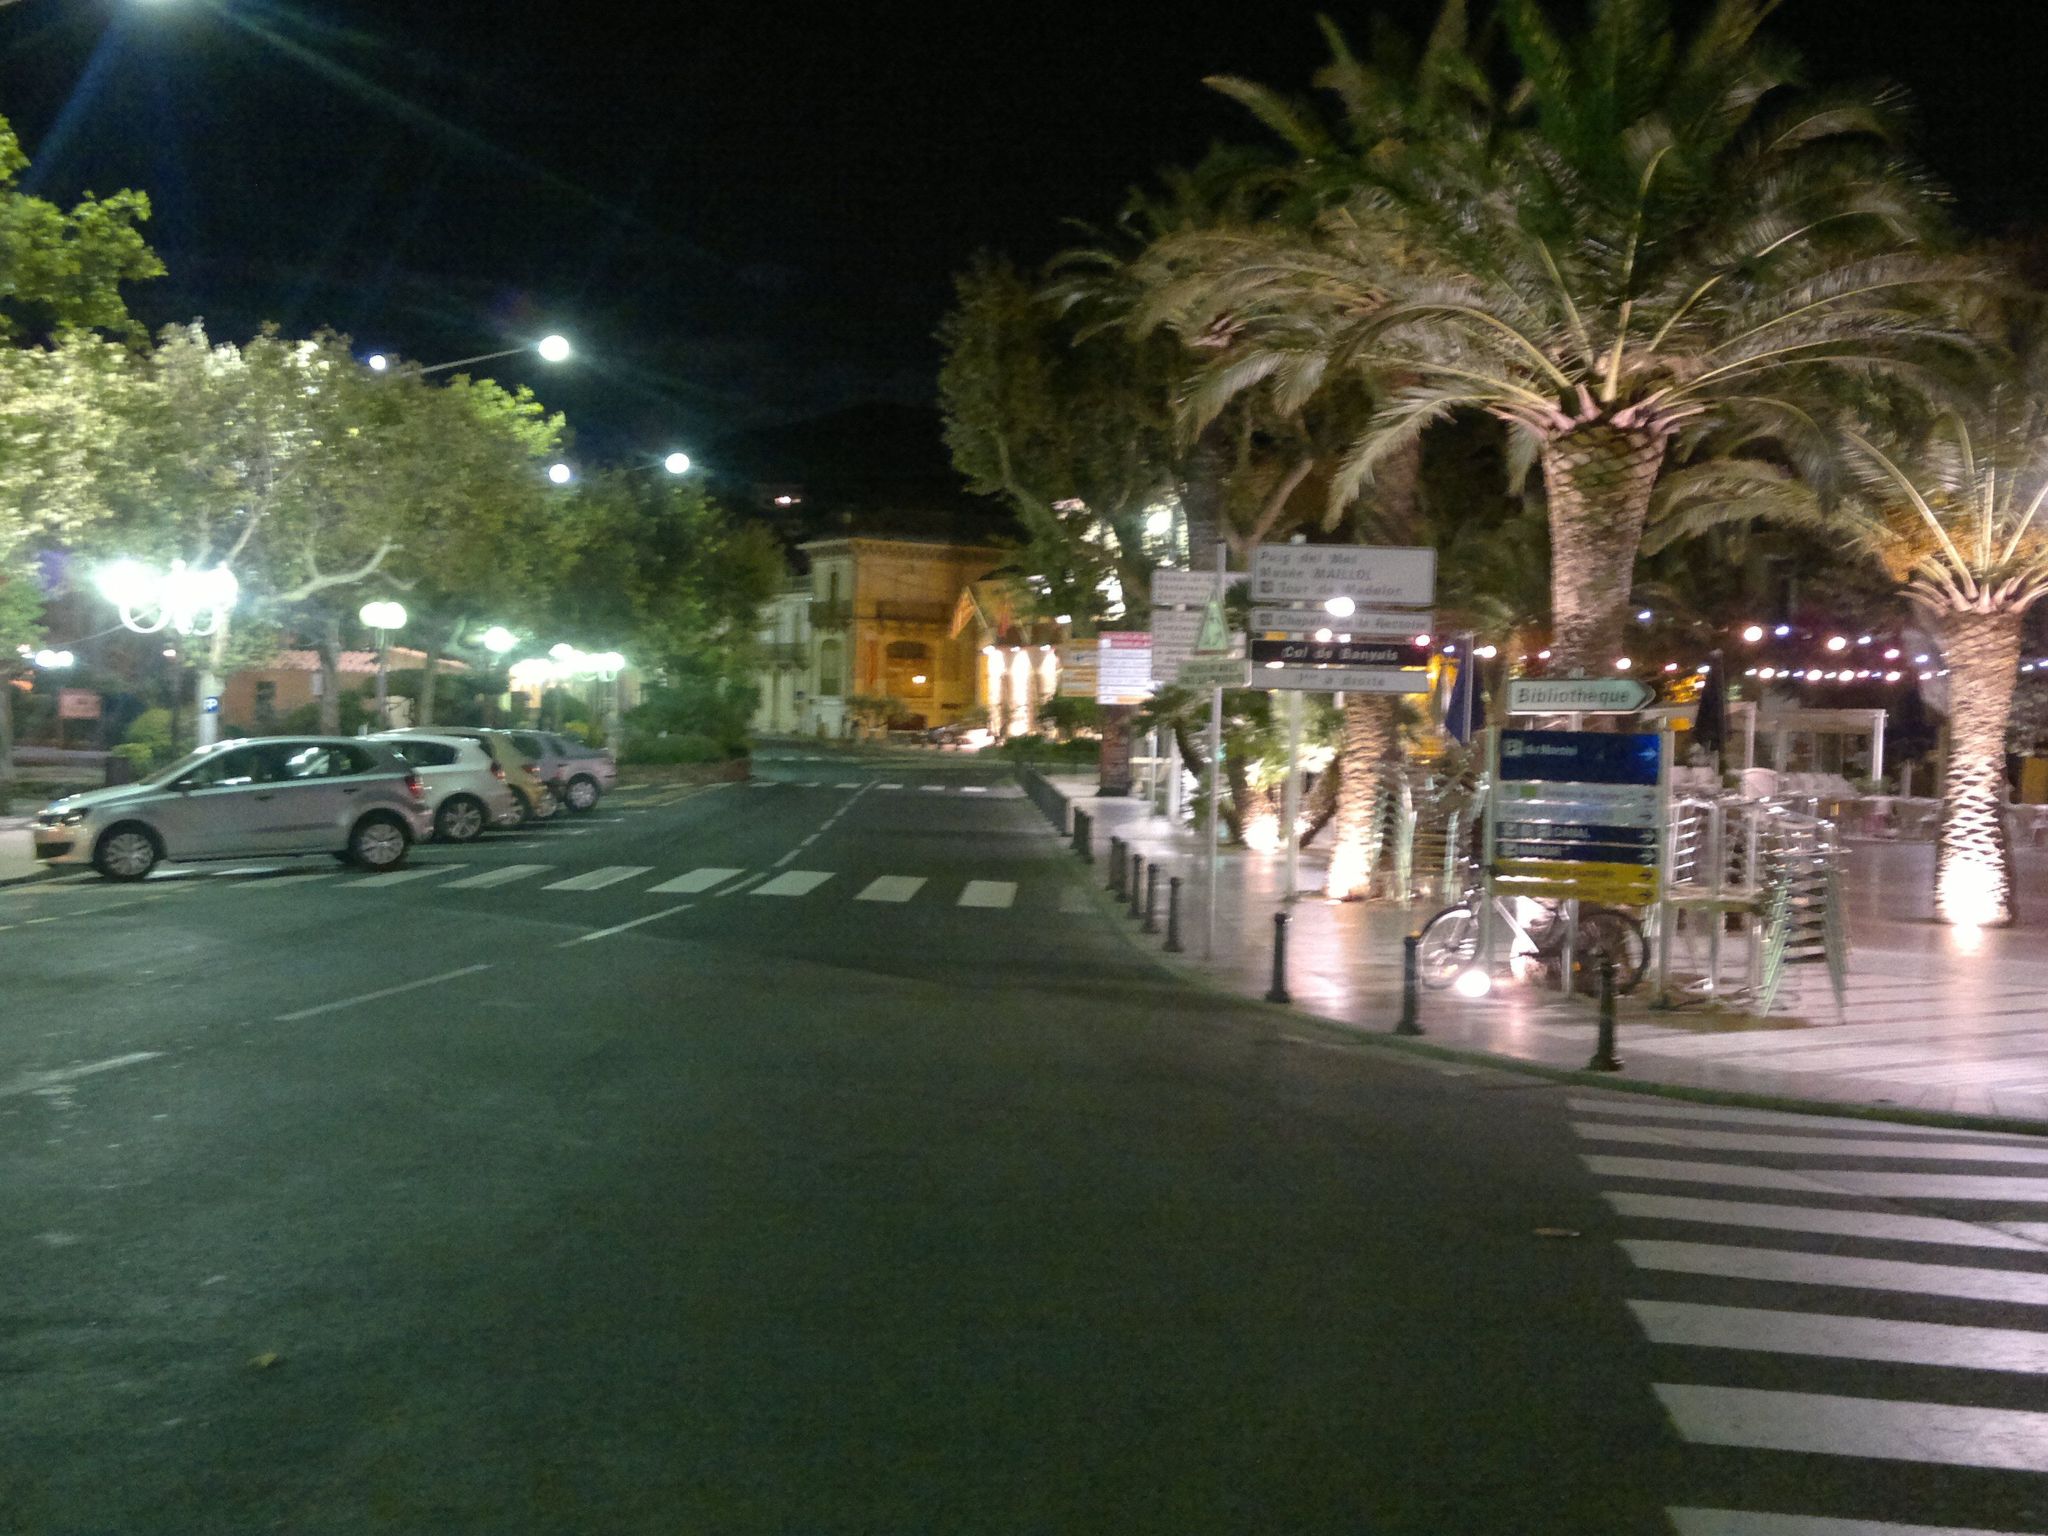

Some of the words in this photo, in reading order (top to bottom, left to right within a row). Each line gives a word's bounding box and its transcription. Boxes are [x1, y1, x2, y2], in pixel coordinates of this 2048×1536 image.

[1281, 645, 1308, 659] Col
[1314, 646, 1333, 659] de
[1339, 648, 1399, 662] Banyuls
